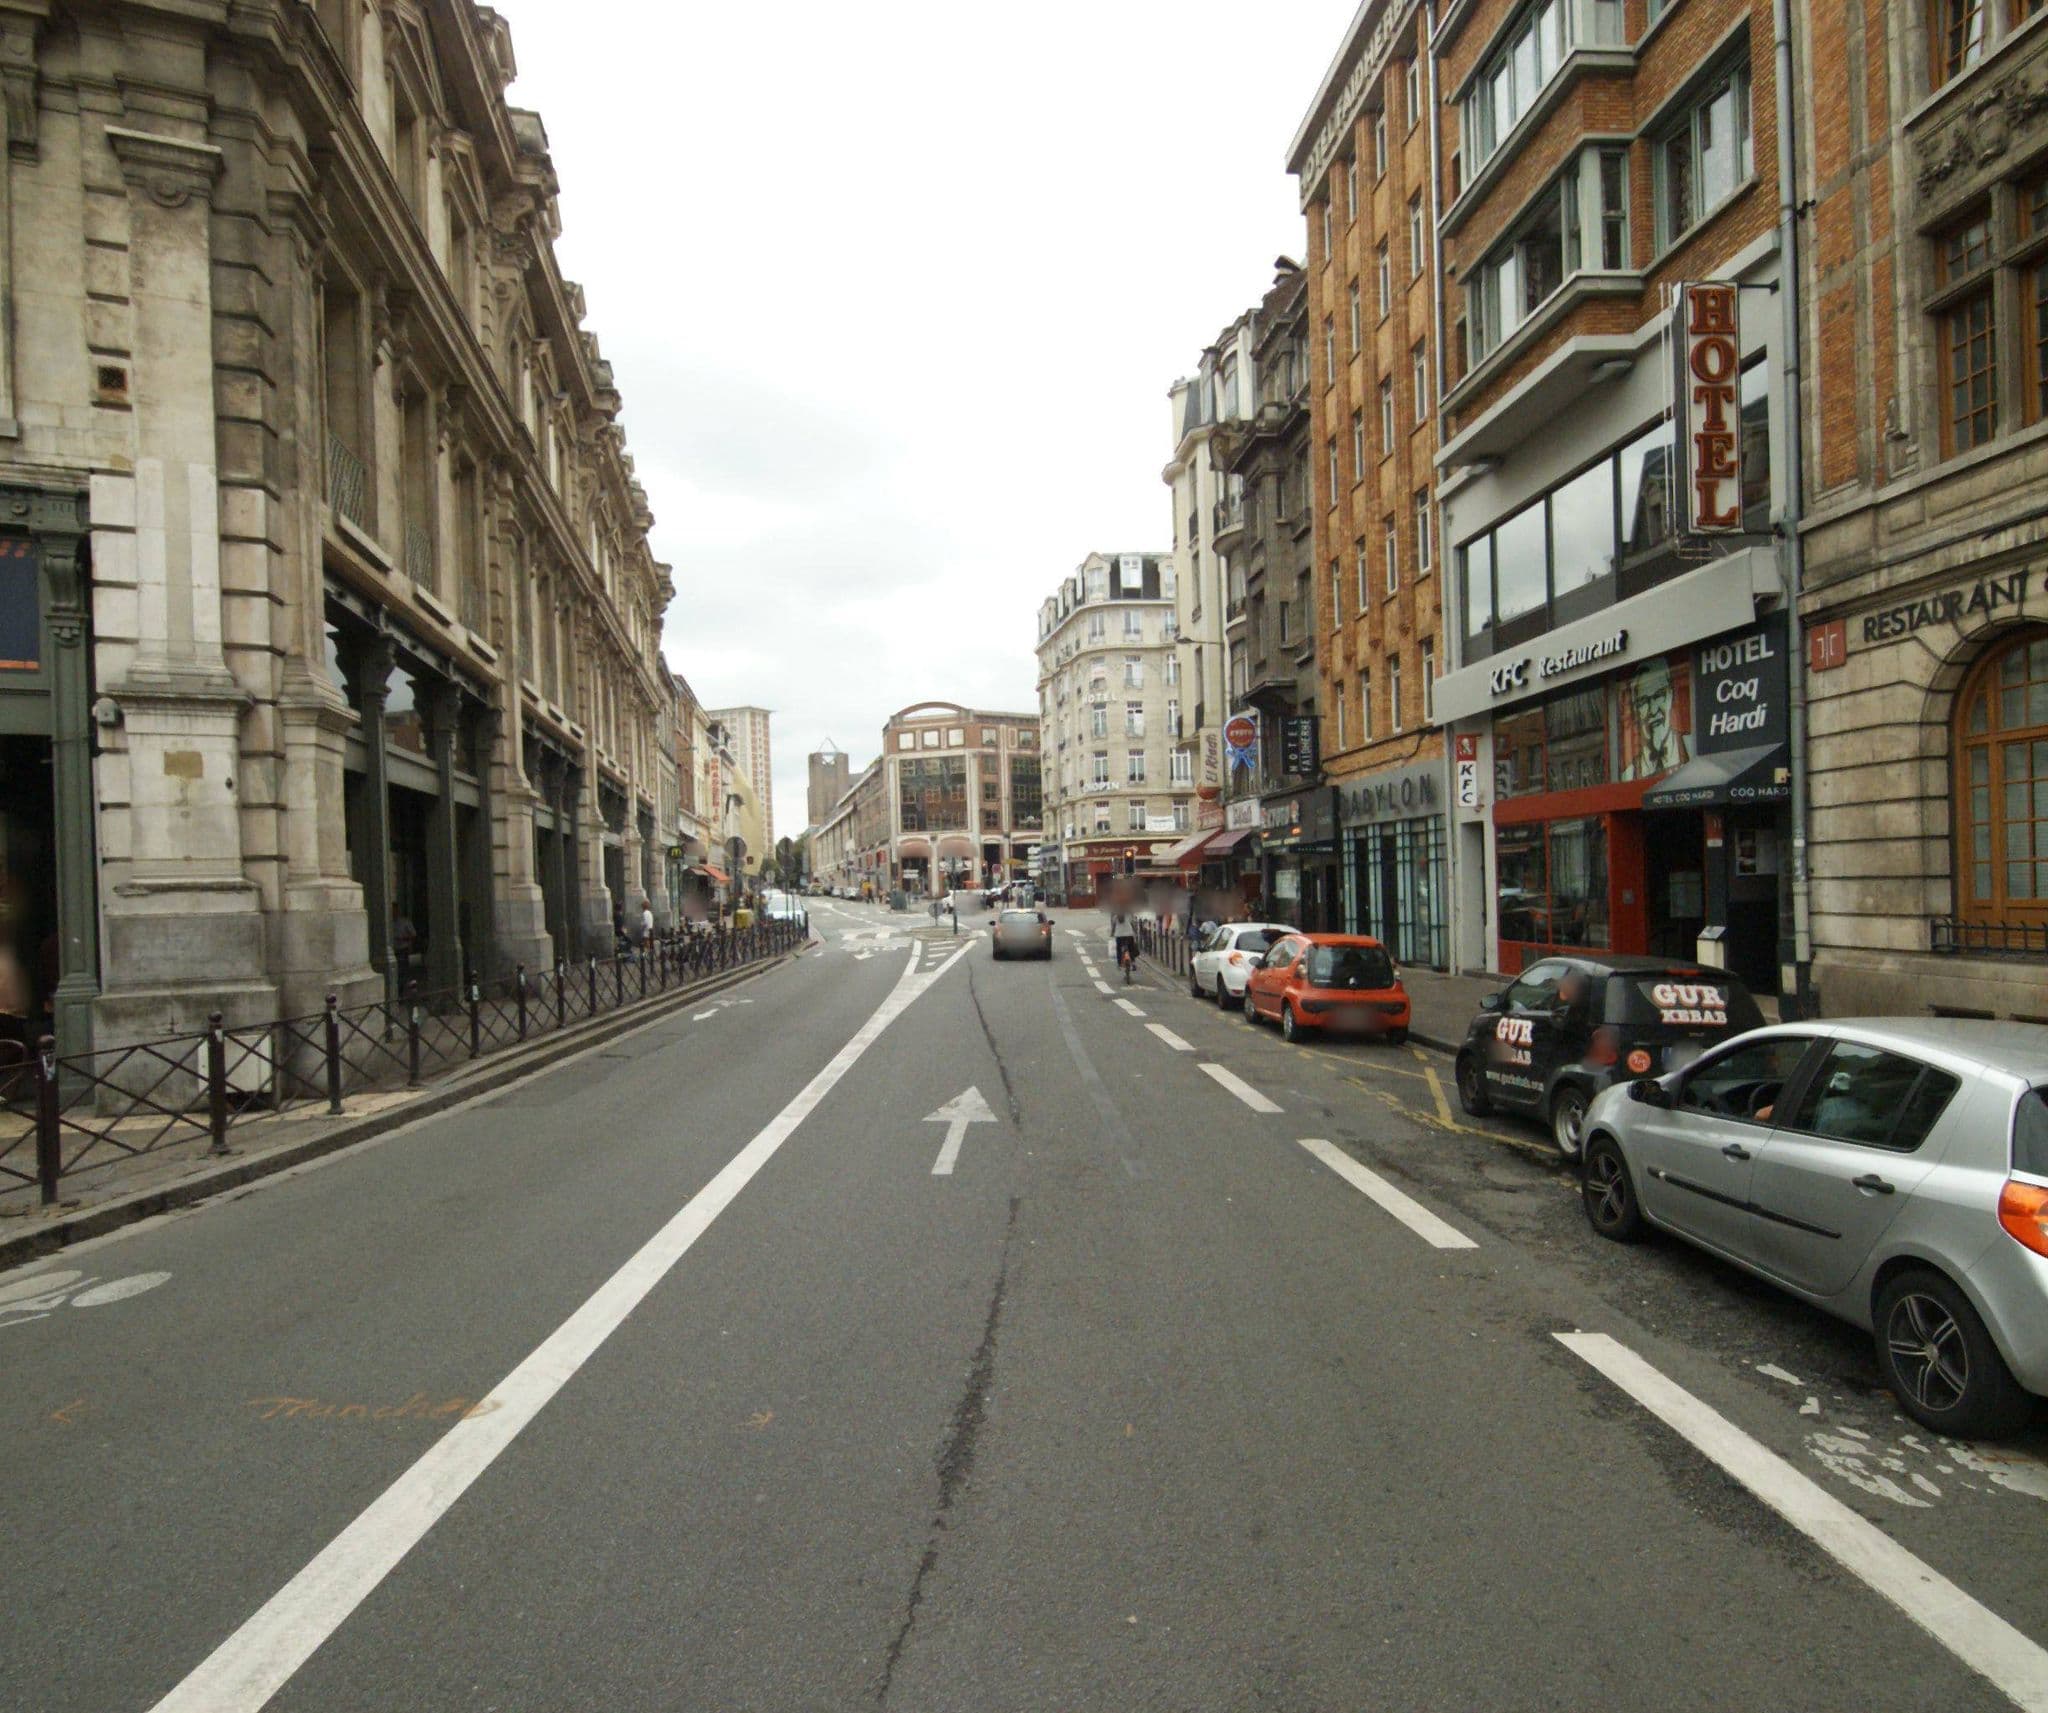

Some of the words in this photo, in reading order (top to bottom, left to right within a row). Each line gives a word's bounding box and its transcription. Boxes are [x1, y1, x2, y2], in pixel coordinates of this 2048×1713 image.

[1689, 287, 1738, 526] HOTEL
[1863, 569, 2029, 643] RESTAURANT
[1490, 659, 1531, 694] KFC
[1537, 629, 1628, 677] Restaurant
[1701, 633, 1775, 675] HOTEL
[1716, 677, 1759, 703] Coq
[1709, 702, 1768, 736] Hardi
[1461, 764, 1473, 804] KFC
[1652, 983, 1727, 1009] GUR
[1496, 1016, 1533, 1048] GUR
